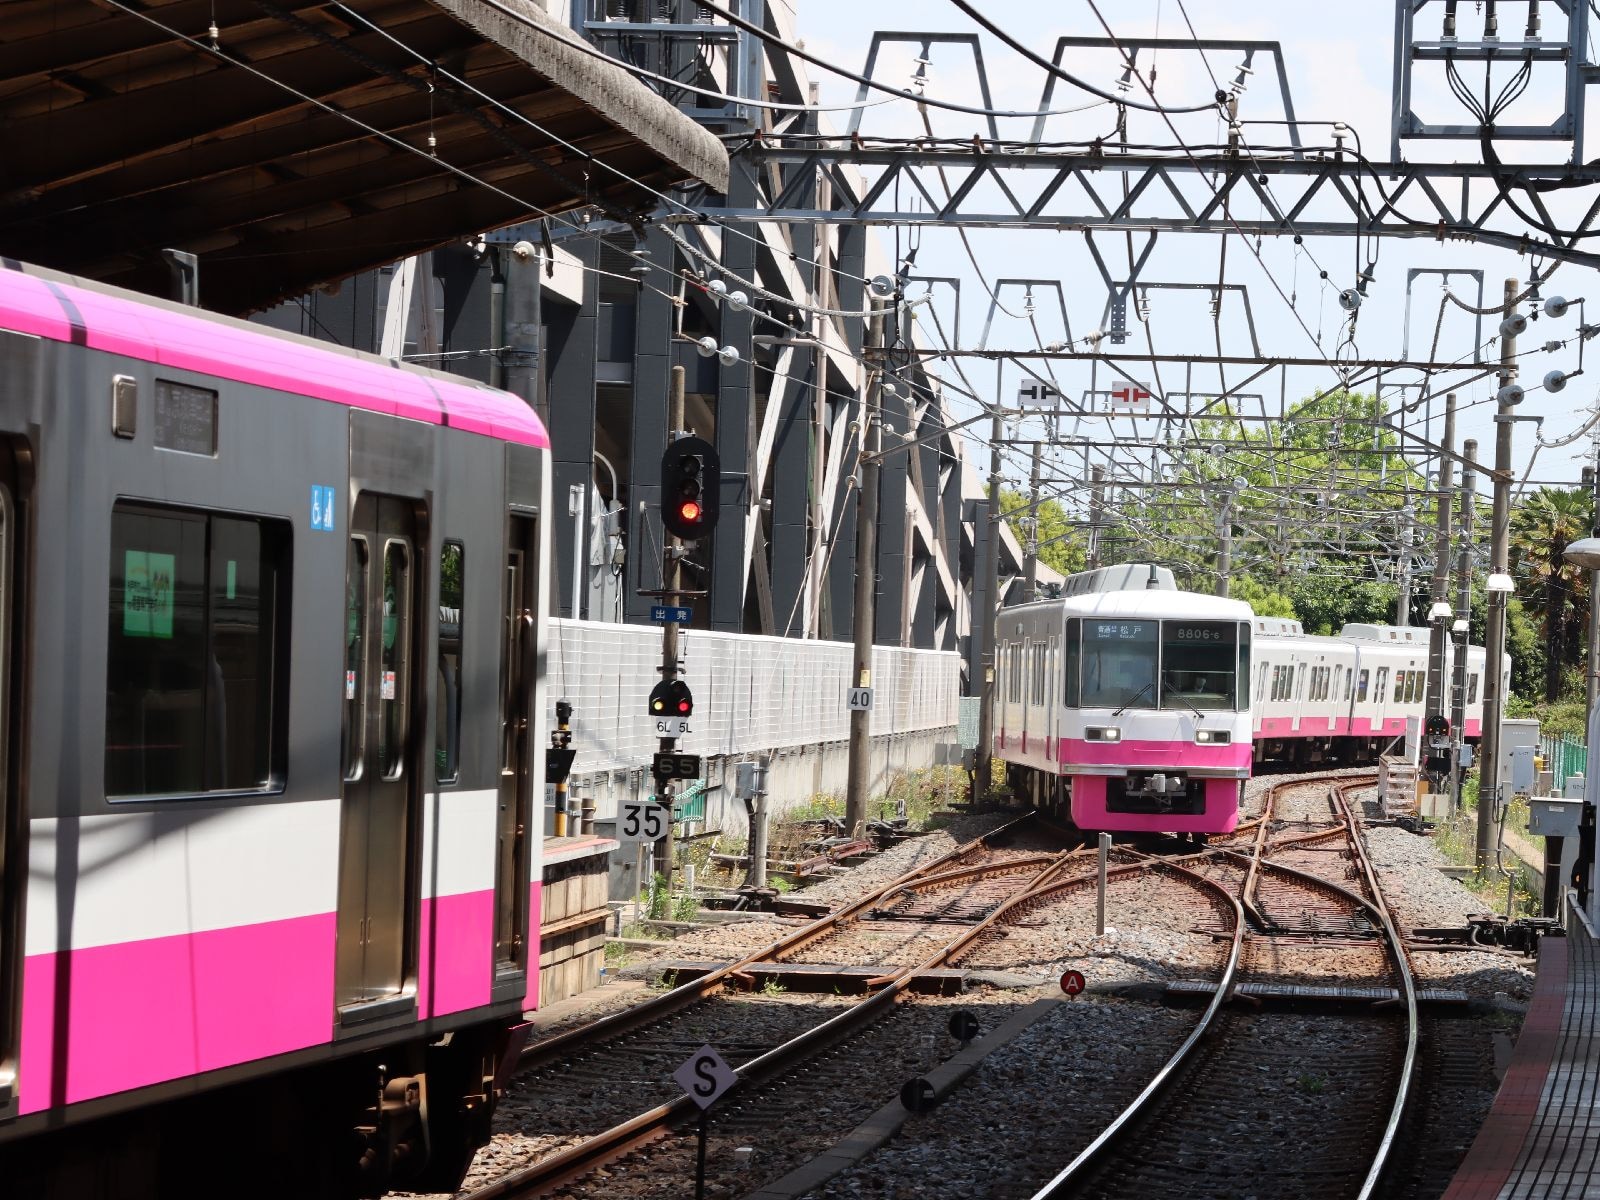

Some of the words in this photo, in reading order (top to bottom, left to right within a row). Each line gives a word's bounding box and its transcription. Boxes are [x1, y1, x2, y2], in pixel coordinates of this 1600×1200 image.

[655, 609, 687, 620] 出発
[1119, 625, 1142, 635] 松戸
[1177, 628, 1220, 640] 8806-6
[850, 691, 870, 707] 40
[656, 721, 671, 733] 6L
[679, 722, 693, 734] 5L
[623, 804, 662, 838] 35
[1065, 975, 1079, 990] A
[693, 1055, 717, 1098] S
